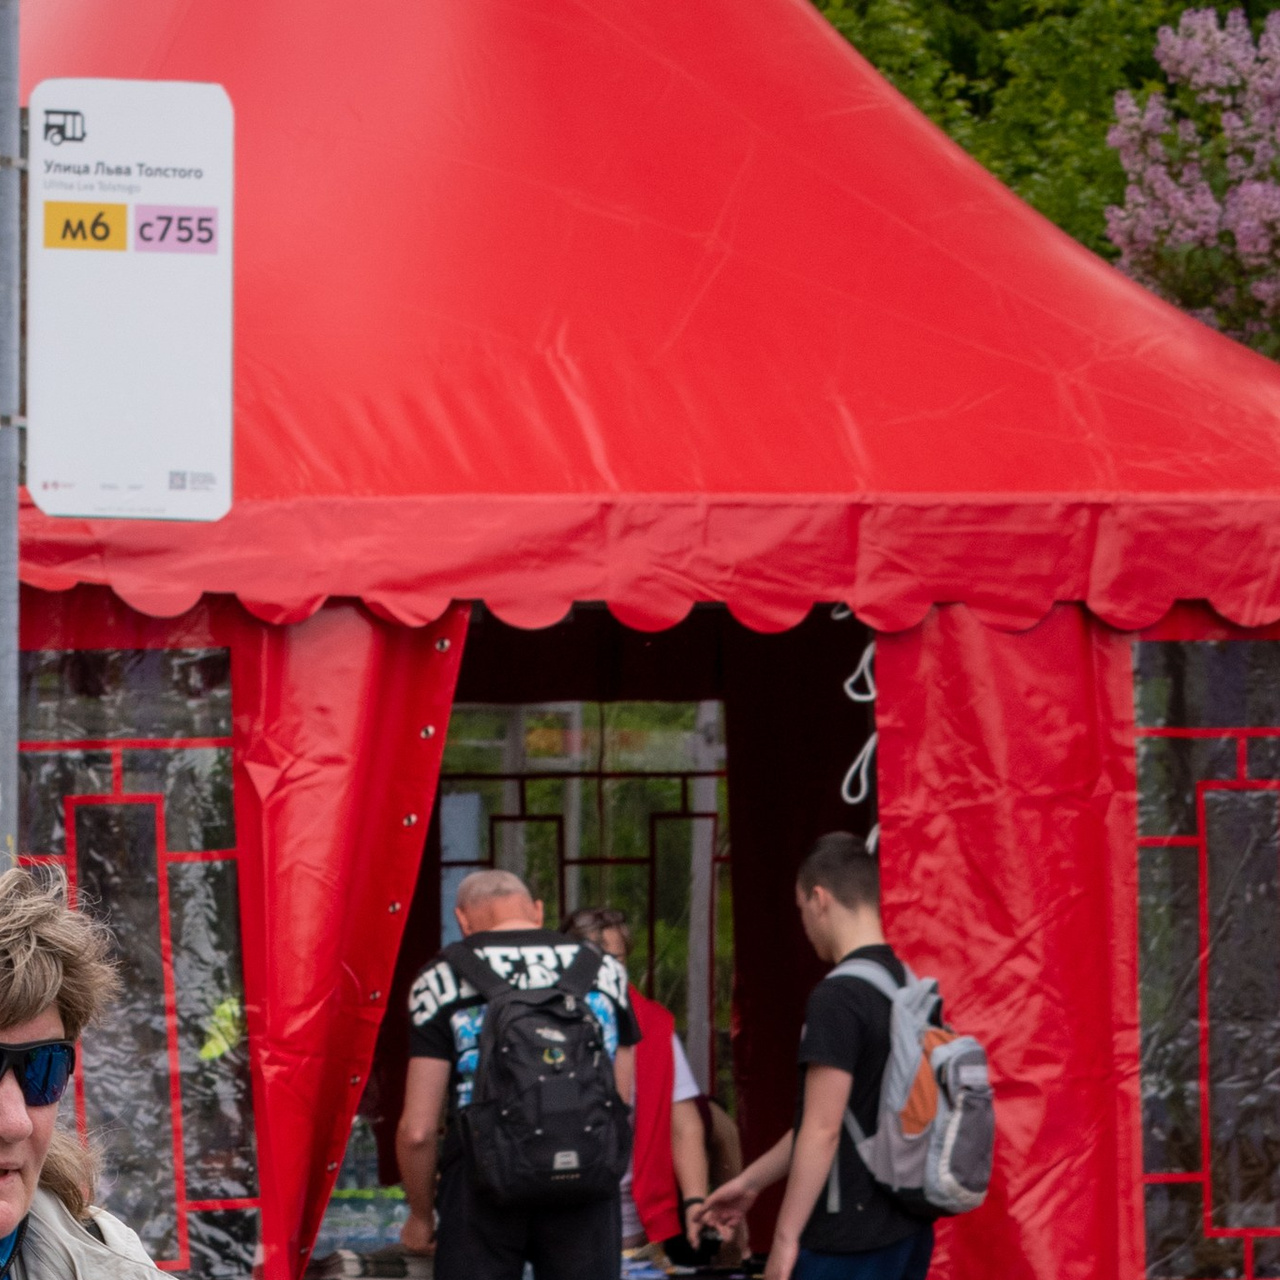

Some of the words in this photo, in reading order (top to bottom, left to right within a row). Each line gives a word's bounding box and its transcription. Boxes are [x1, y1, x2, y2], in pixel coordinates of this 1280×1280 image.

[44, 160, 90, 175] Улица
[94, 162, 131, 177] Льва
[136, 163, 203, 179] Толстого
